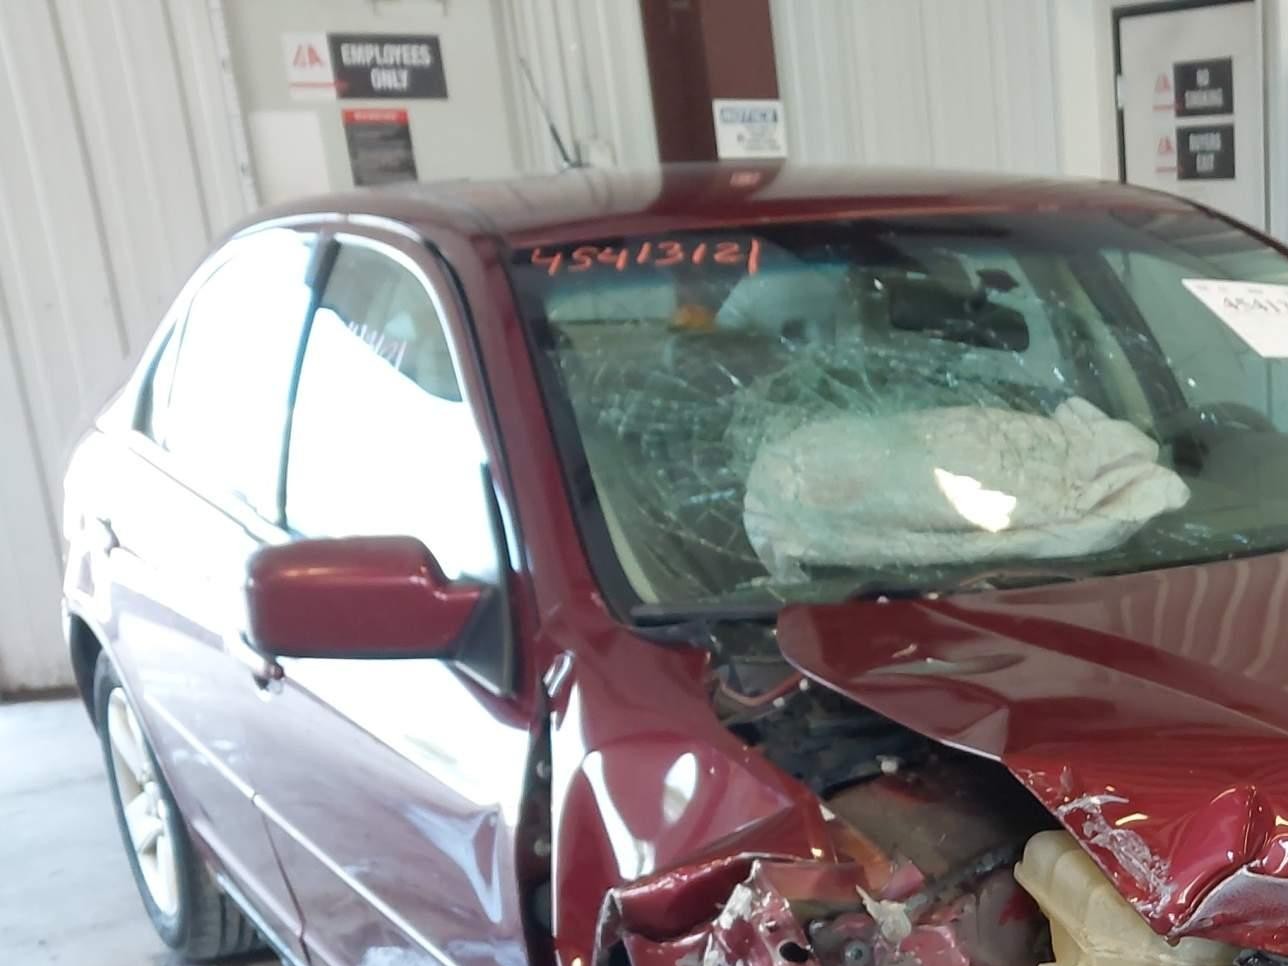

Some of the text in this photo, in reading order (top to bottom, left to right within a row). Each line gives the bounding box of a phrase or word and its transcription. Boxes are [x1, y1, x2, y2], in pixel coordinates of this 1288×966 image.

[340, 43, 432, 67] EMPLOYEES
[370, 68, 409, 91] ONLY
[531, 238, 760, 276] 45413121
